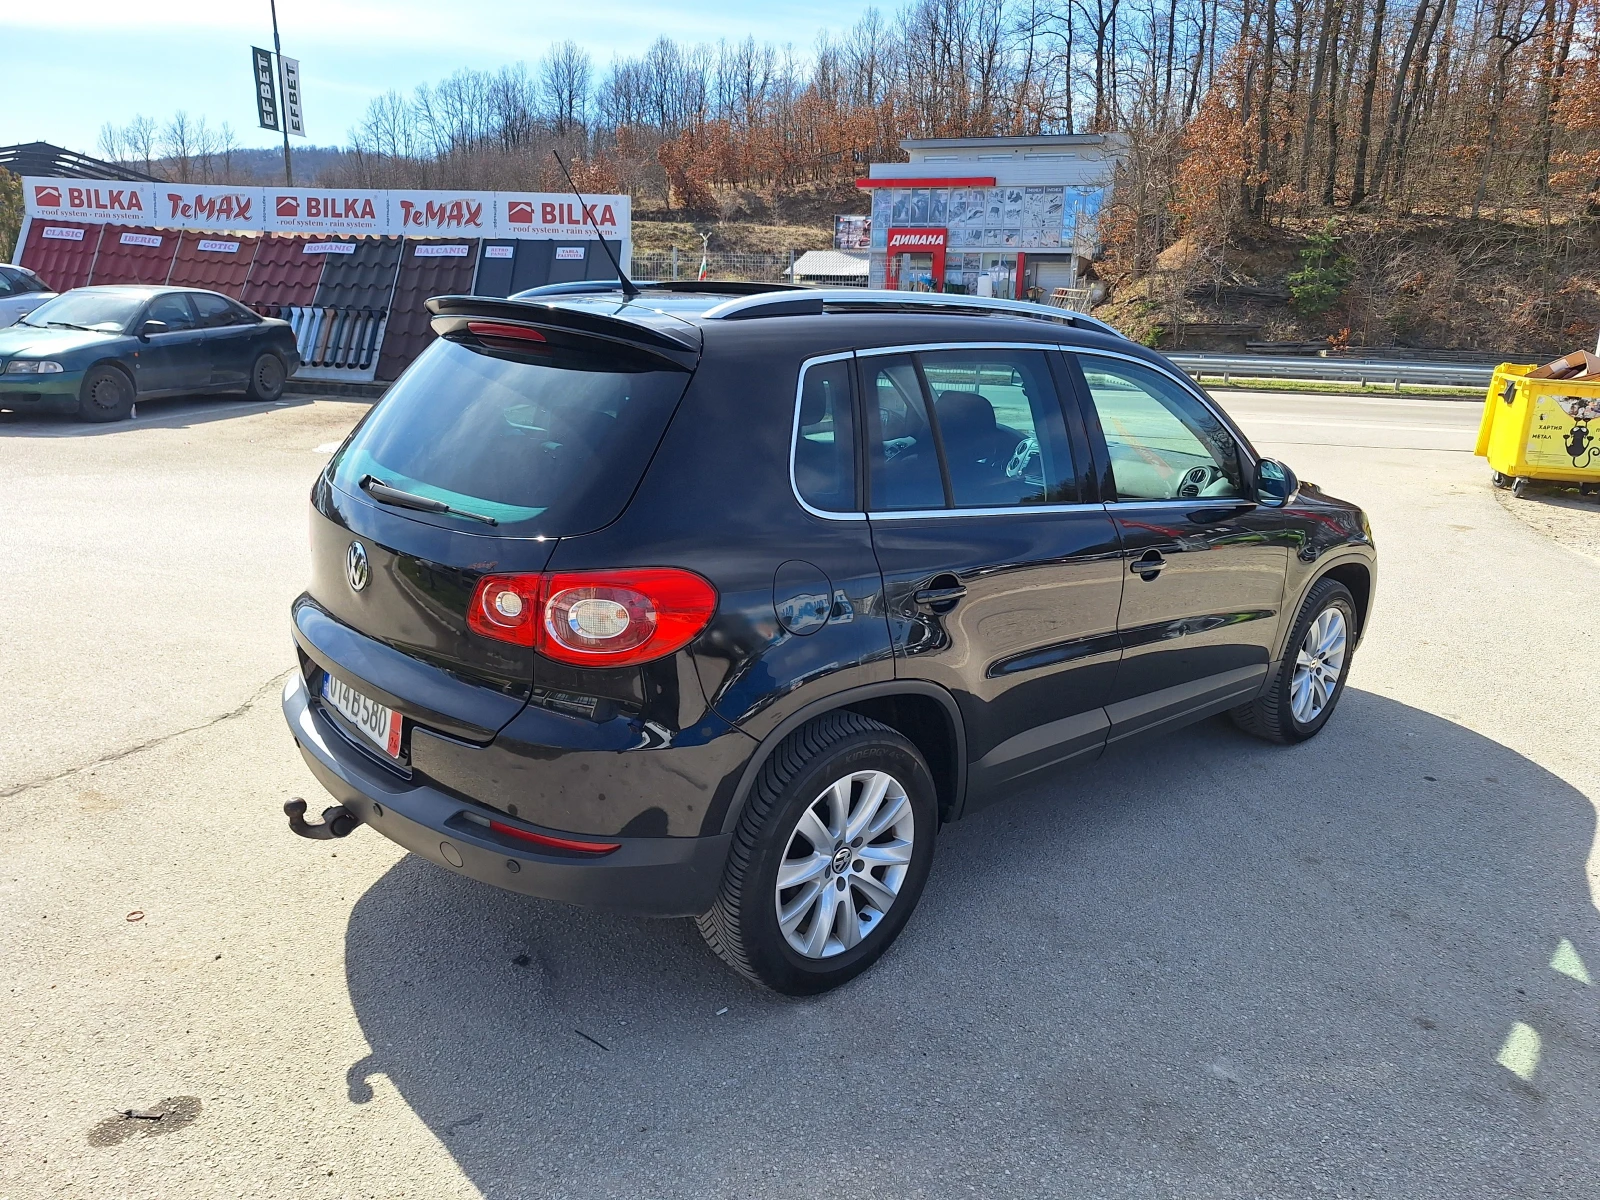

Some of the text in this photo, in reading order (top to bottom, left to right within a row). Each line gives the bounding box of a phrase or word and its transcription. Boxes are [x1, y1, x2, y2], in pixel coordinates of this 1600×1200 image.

[257, 53, 275, 126] EFBET
[286, 62, 301, 131] EFBET
[68, 188, 143, 211] BILKA
[167, 193, 253, 222] TeMAX
[306, 197, 376, 219] BILKA
[41, 208, 60, 216] roof
[60, 210, 88, 218] system
[113, 212, 140, 220] system
[400, 200, 483, 229] TeMAX
[541, 202, 617, 227] BILKA
[297, 219, 324, 227] system
[513, 225, 531, 233] roof
[584, 228, 613, 236] sysem
[45, 228, 82, 238] CLASIC
[123, 235, 159, 244] IBERIC
[889, 234, 944, 246] ДИМАНА
[307, 244, 353, 252] ROMANIC
